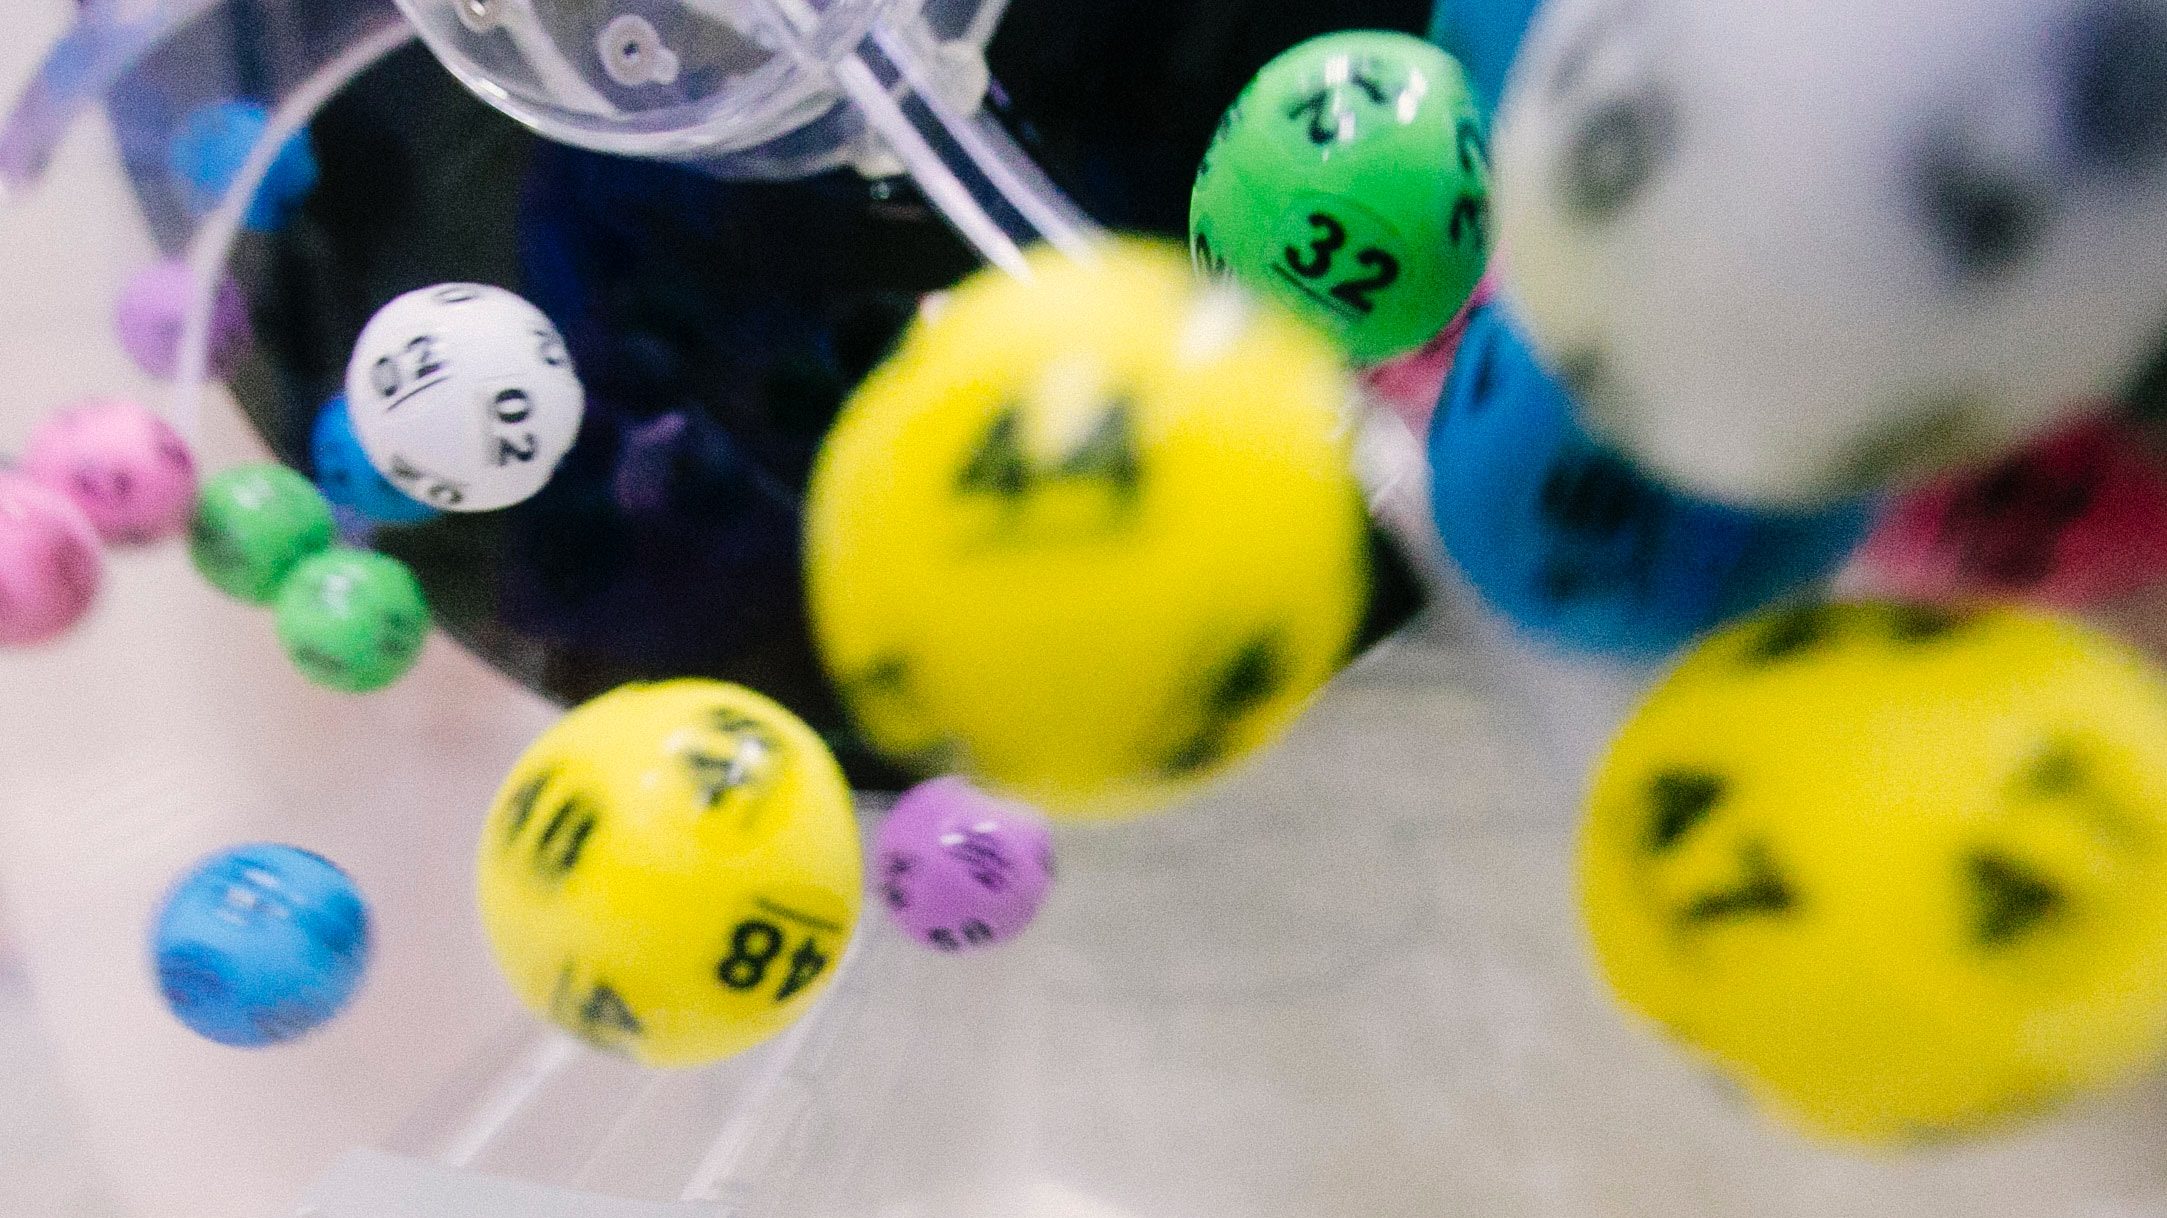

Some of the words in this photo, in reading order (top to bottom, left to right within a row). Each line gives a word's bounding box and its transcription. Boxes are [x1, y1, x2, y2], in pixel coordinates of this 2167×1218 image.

[1284, 211, 1401, 315] 32
[489, 387, 538, 467] 02
[716, 920, 829, 1003] 48
